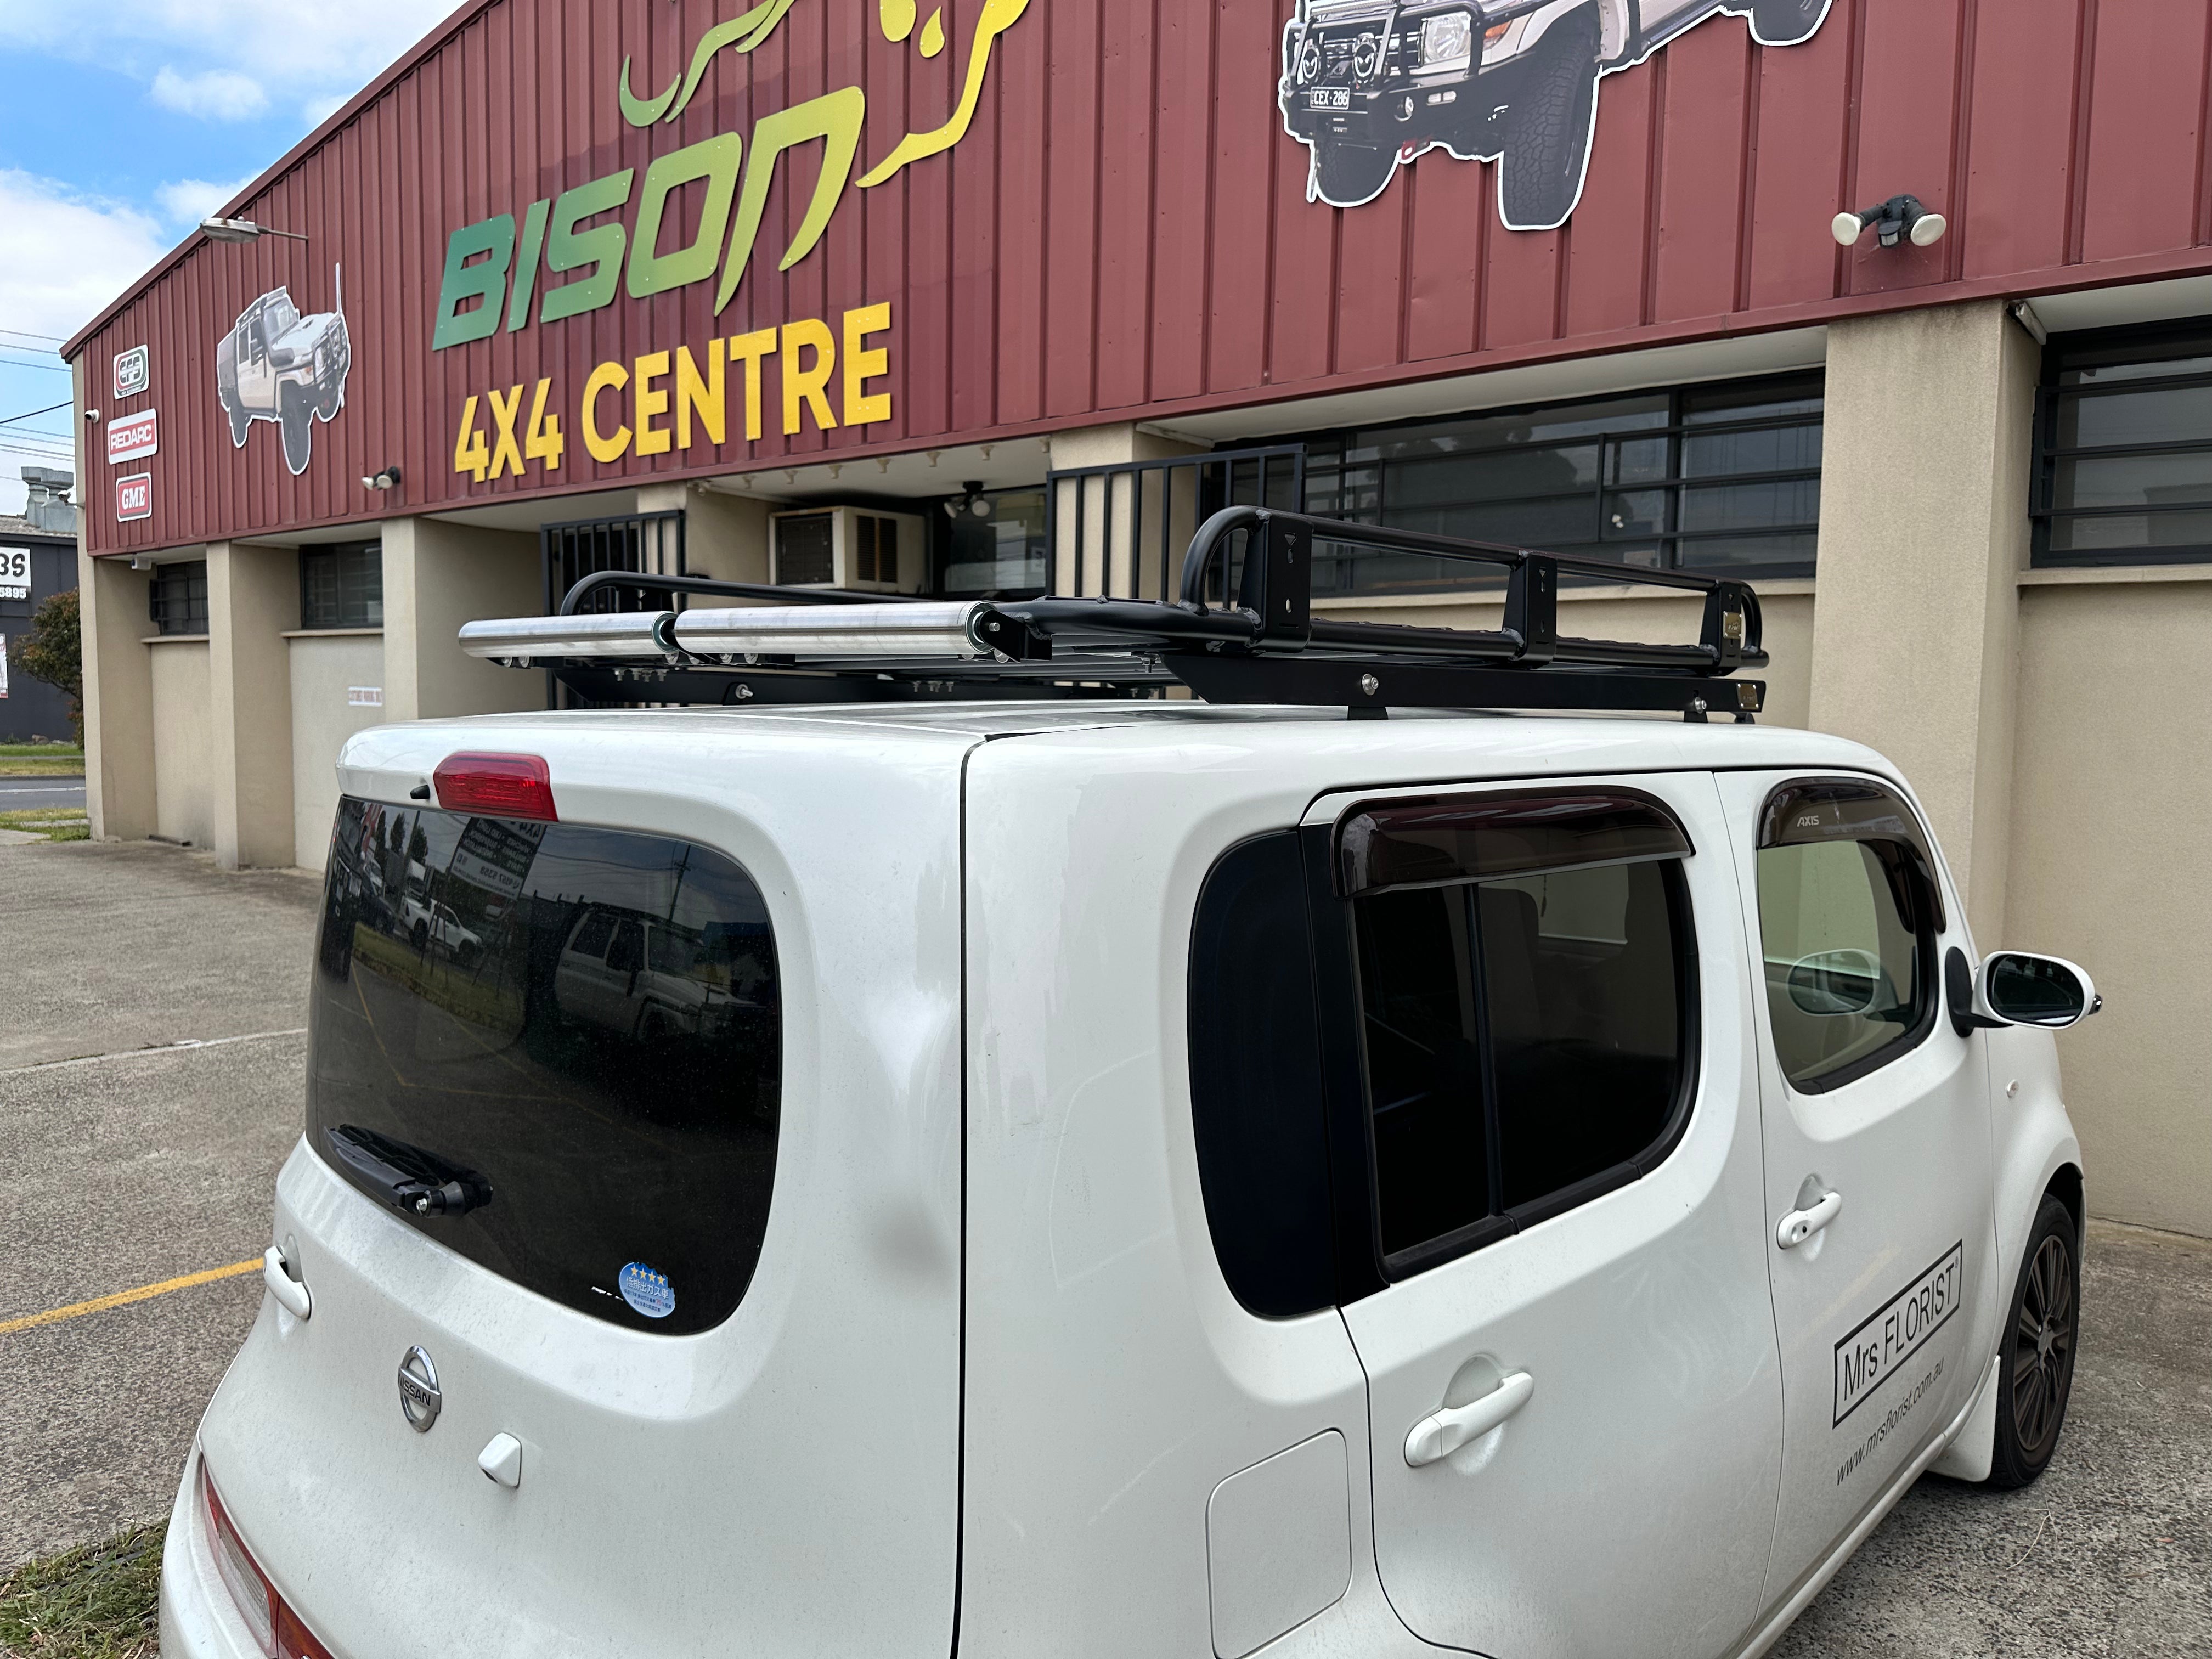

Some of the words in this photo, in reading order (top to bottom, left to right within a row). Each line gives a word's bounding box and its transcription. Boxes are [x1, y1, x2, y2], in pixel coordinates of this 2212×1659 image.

[454, 377, 563, 483] 4X4
[582, 301, 891, 464] CENTRE
[111, 424, 152, 450] REDARC
[122, 485, 145, 510] GME
[1797, 815, 1819, 827] AXIS
[1844, 1342, 1878, 1401] Mrs
[1884, 1262, 1954, 1365] FLORIST
[398, 1372, 431, 1407] NISSAN
[1836, 1357, 1944, 1486] www.mrsflorist.com.au
